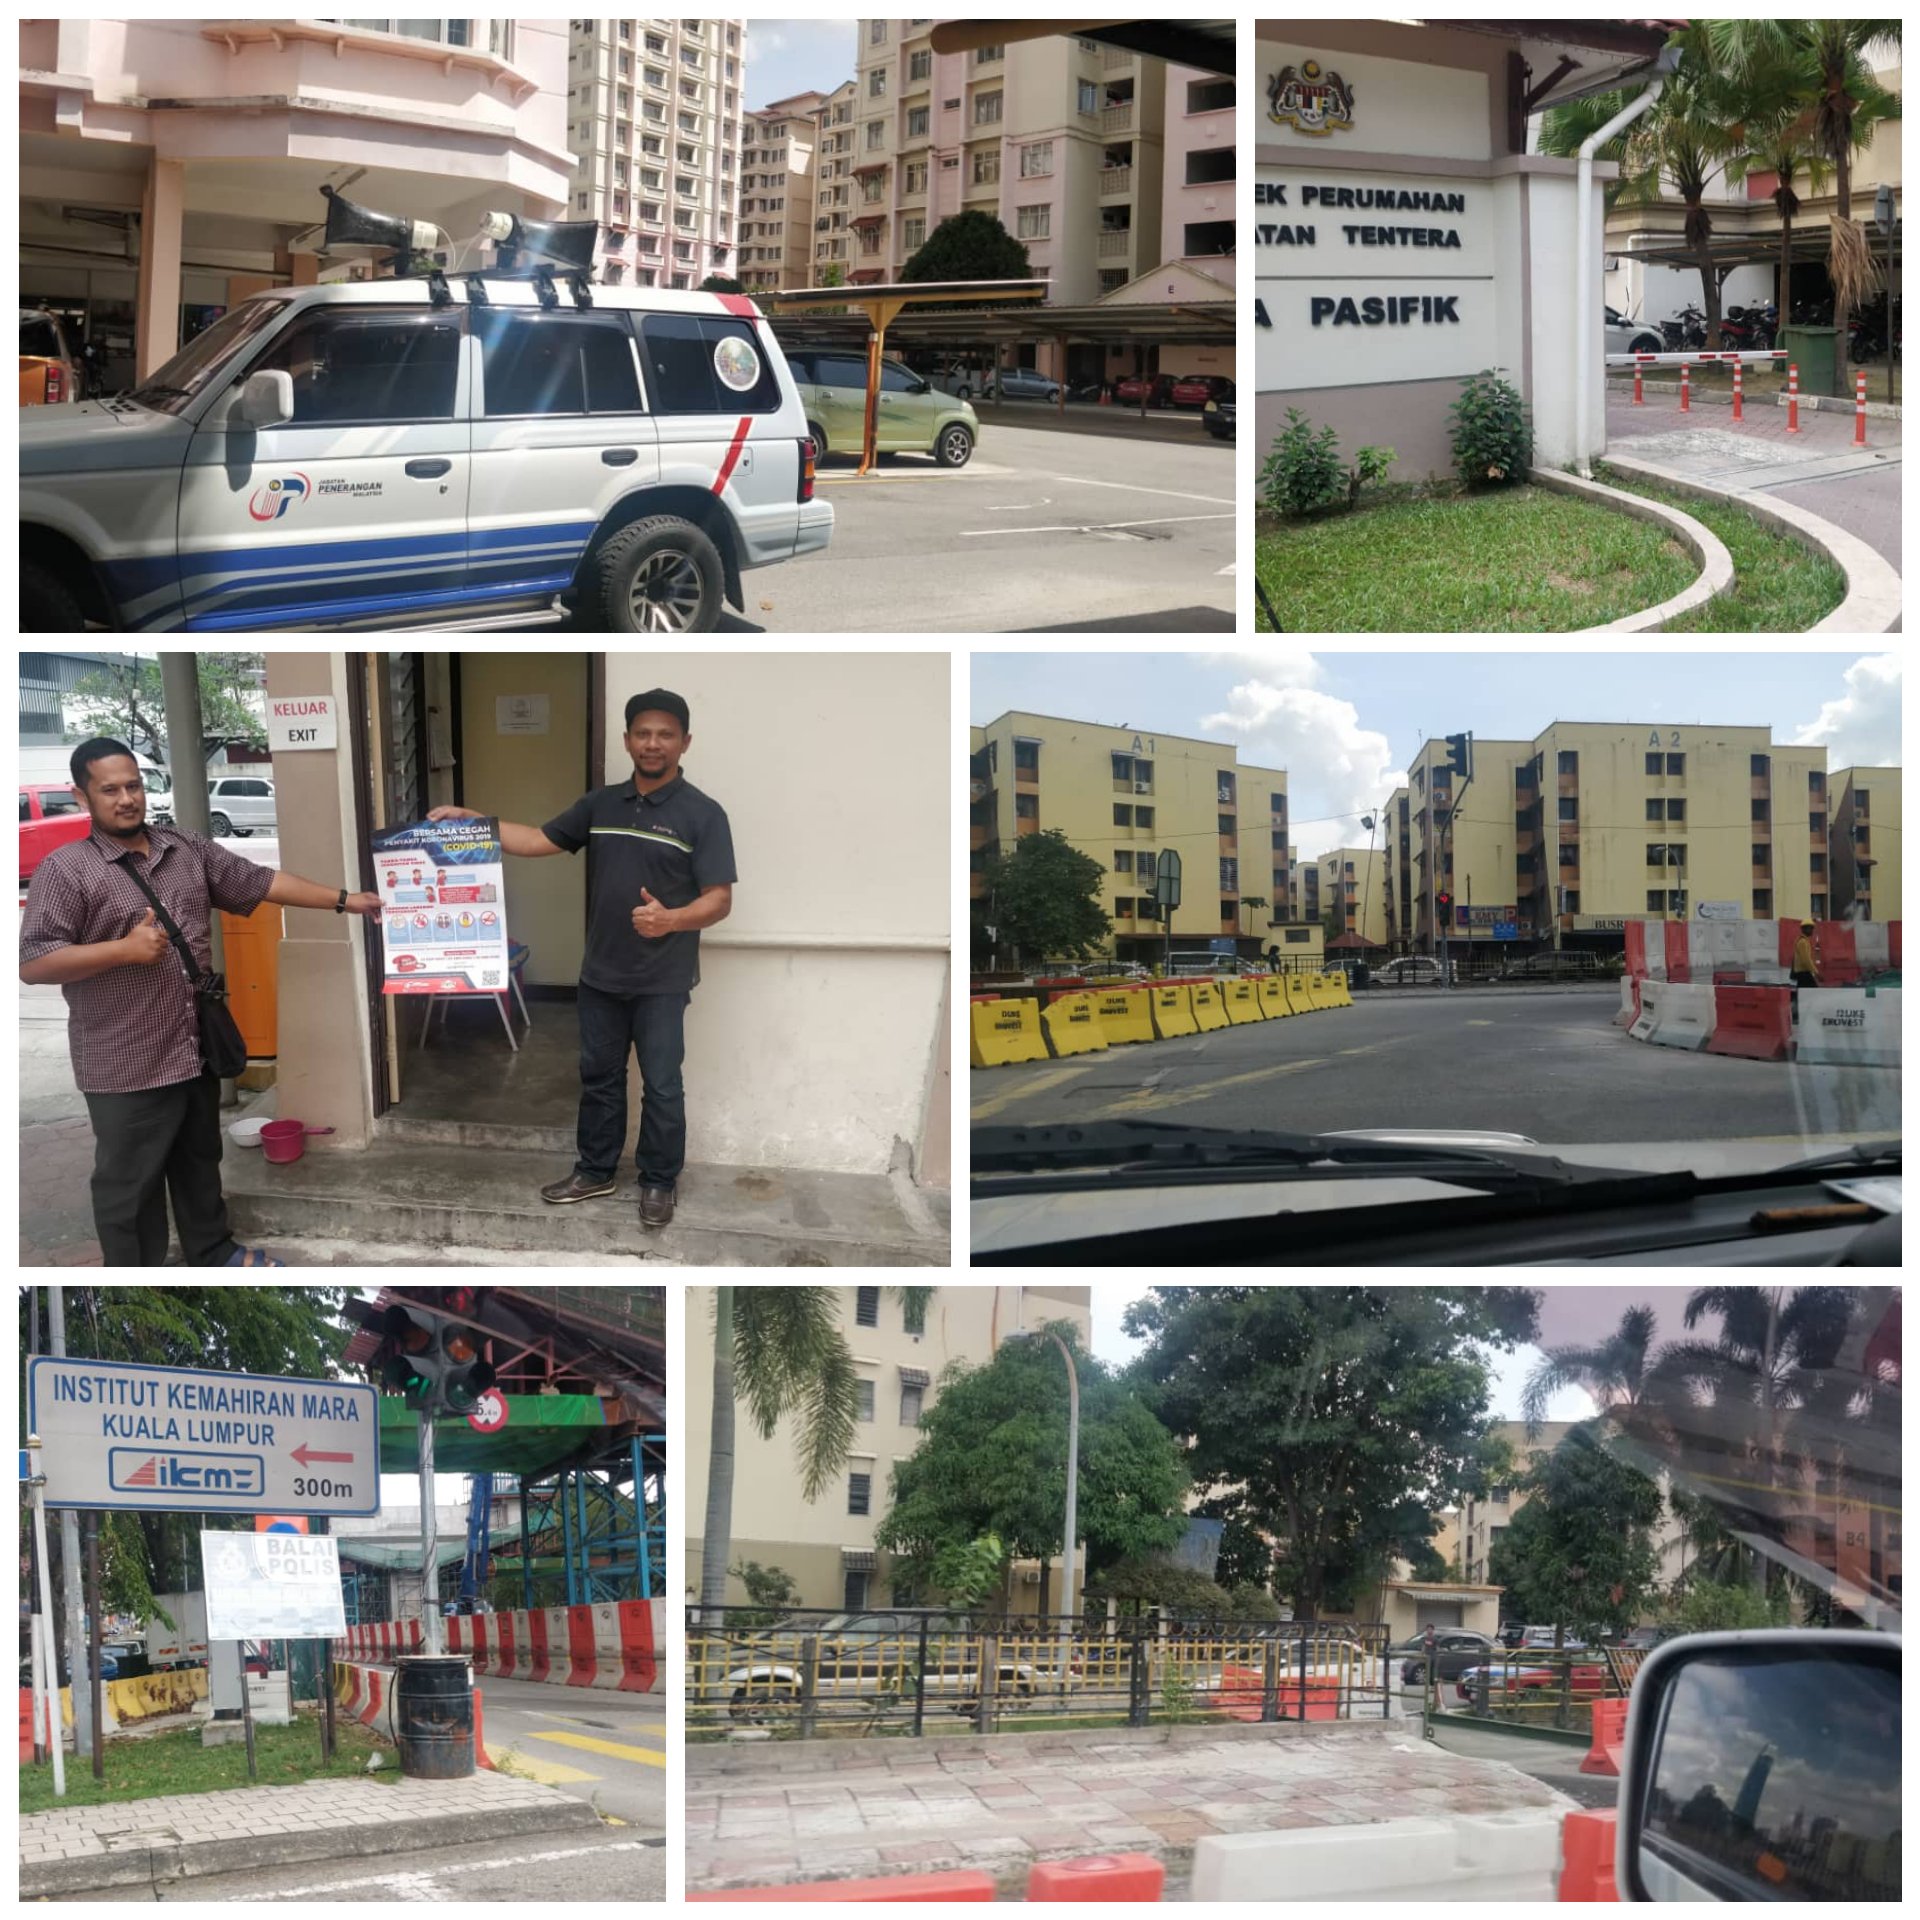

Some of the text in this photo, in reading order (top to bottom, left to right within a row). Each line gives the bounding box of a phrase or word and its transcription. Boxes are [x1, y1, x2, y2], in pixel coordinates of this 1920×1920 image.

[1302, 185, 1465, 213] PERUMAHAN
[1342, 225, 1461, 248] TENTERA
[1311, 296, 1460, 326] PASIFIK
[318, 482, 383, 494] PENERANGAN
[274, 701, 328, 716] KELUAR
[288, 728, 317, 742] EXIT
[413, 825, 491, 837] BERSAMA CEGAH
[384, 838, 421, 846] PENYAKIT
[421, 835, 474, 844] KORONAVIRUS
[443, 841, 494, 852] (COVID-19)
[54, 1374, 360, 1422] INSTITUT KEMAHIRAN MARA
[103, 1414, 275, 1446] KUALA LUMPUR
[294, 1478, 353, 1498] 300m
[267, 1538, 334, 1556] BALAI
[268, 1558, 335, 1576] POLIS
